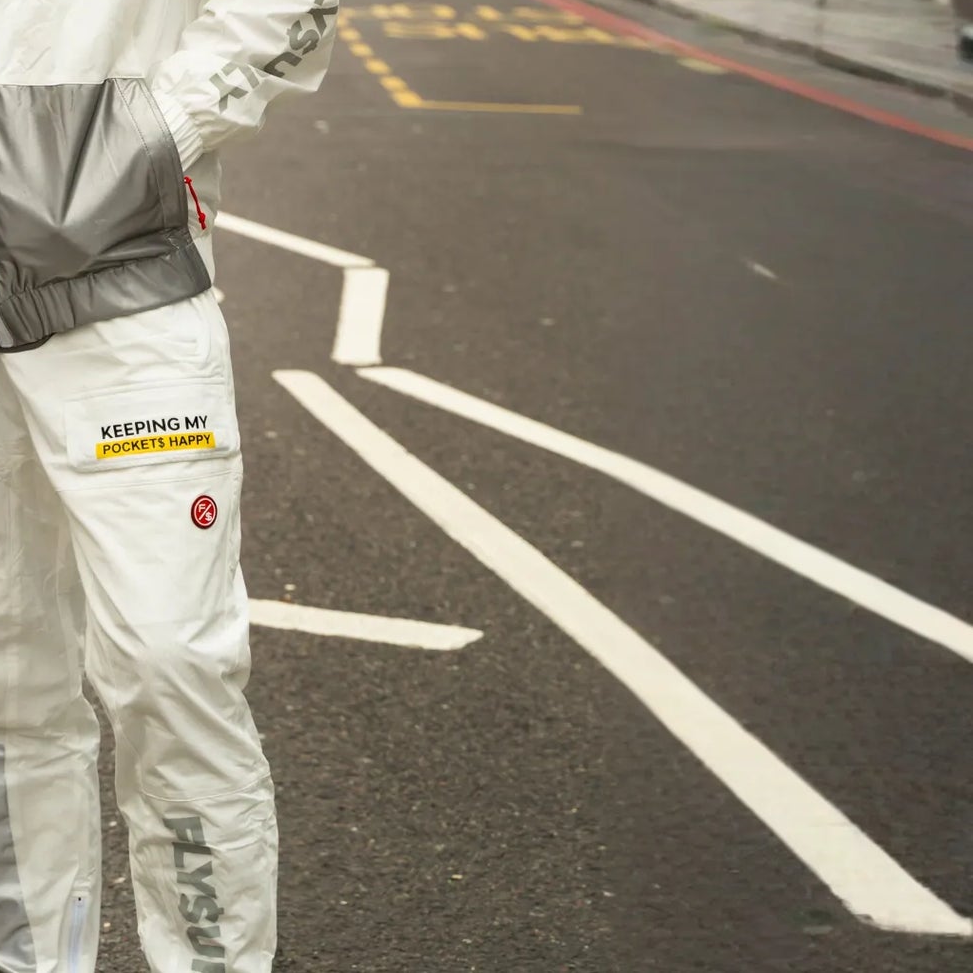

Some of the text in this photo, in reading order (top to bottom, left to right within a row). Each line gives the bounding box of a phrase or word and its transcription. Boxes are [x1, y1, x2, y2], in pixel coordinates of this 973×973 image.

[101, 415, 208, 439] KEEPING MY
[103, 434, 211, 455] POCKET$ HAPPY
